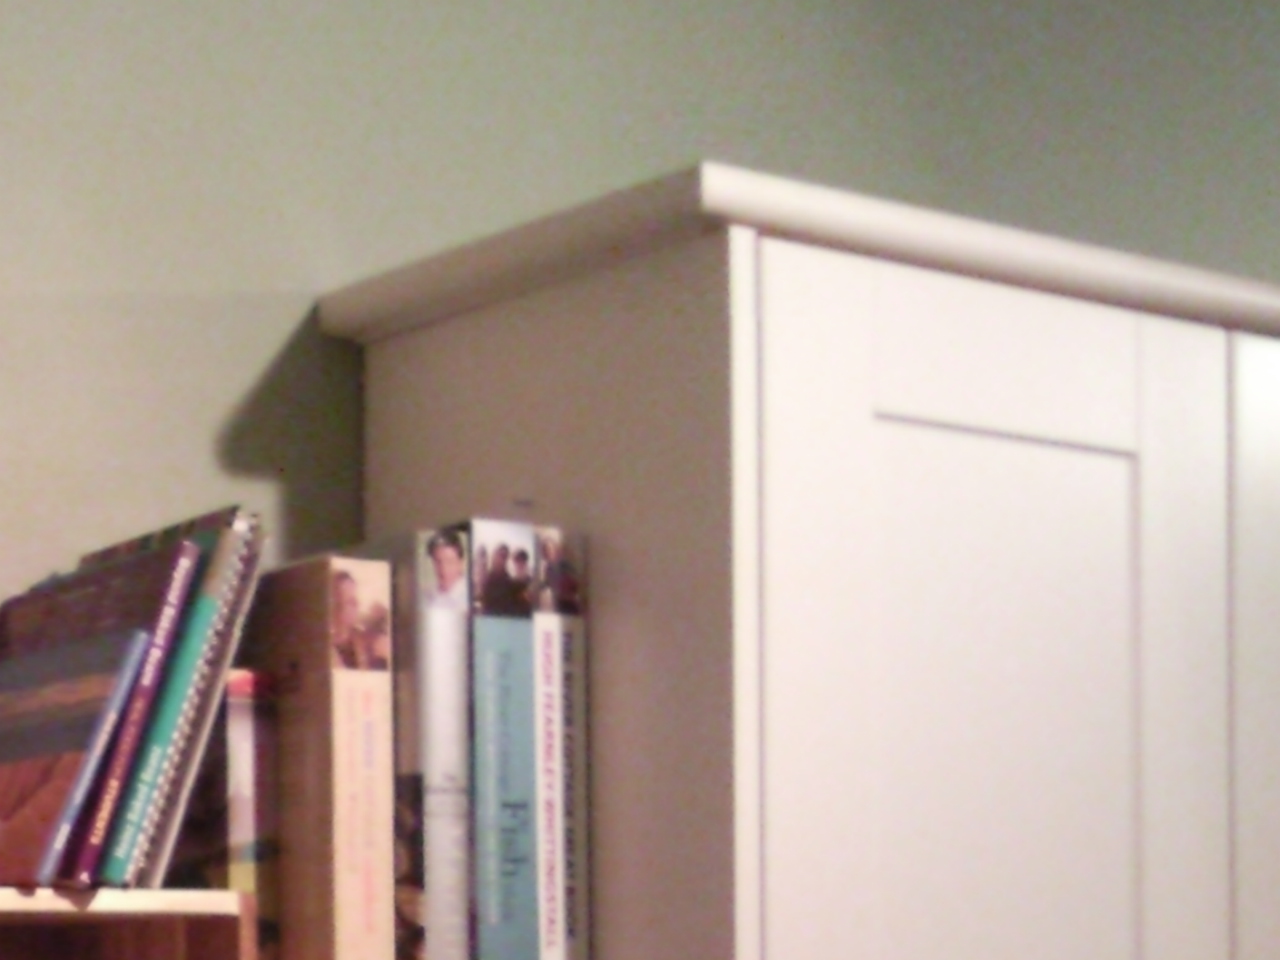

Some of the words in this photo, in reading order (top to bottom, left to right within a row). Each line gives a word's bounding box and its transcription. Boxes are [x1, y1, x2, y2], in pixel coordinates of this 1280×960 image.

[167, 556, 192, 605] Beyond
[153, 604, 176, 646] Baked
[140, 646, 163, 687] Beans
[543, 630, 555, 686] HUGH
[564, 732, 574, 818] COTTAGE
[89, 777, 120, 846] STUDENTS
[127, 782, 150, 824] Baked
[501, 801, 529, 877] Fish
[565, 826, 575, 880] MEAT
[566, 885, 576, 939] BOOK
